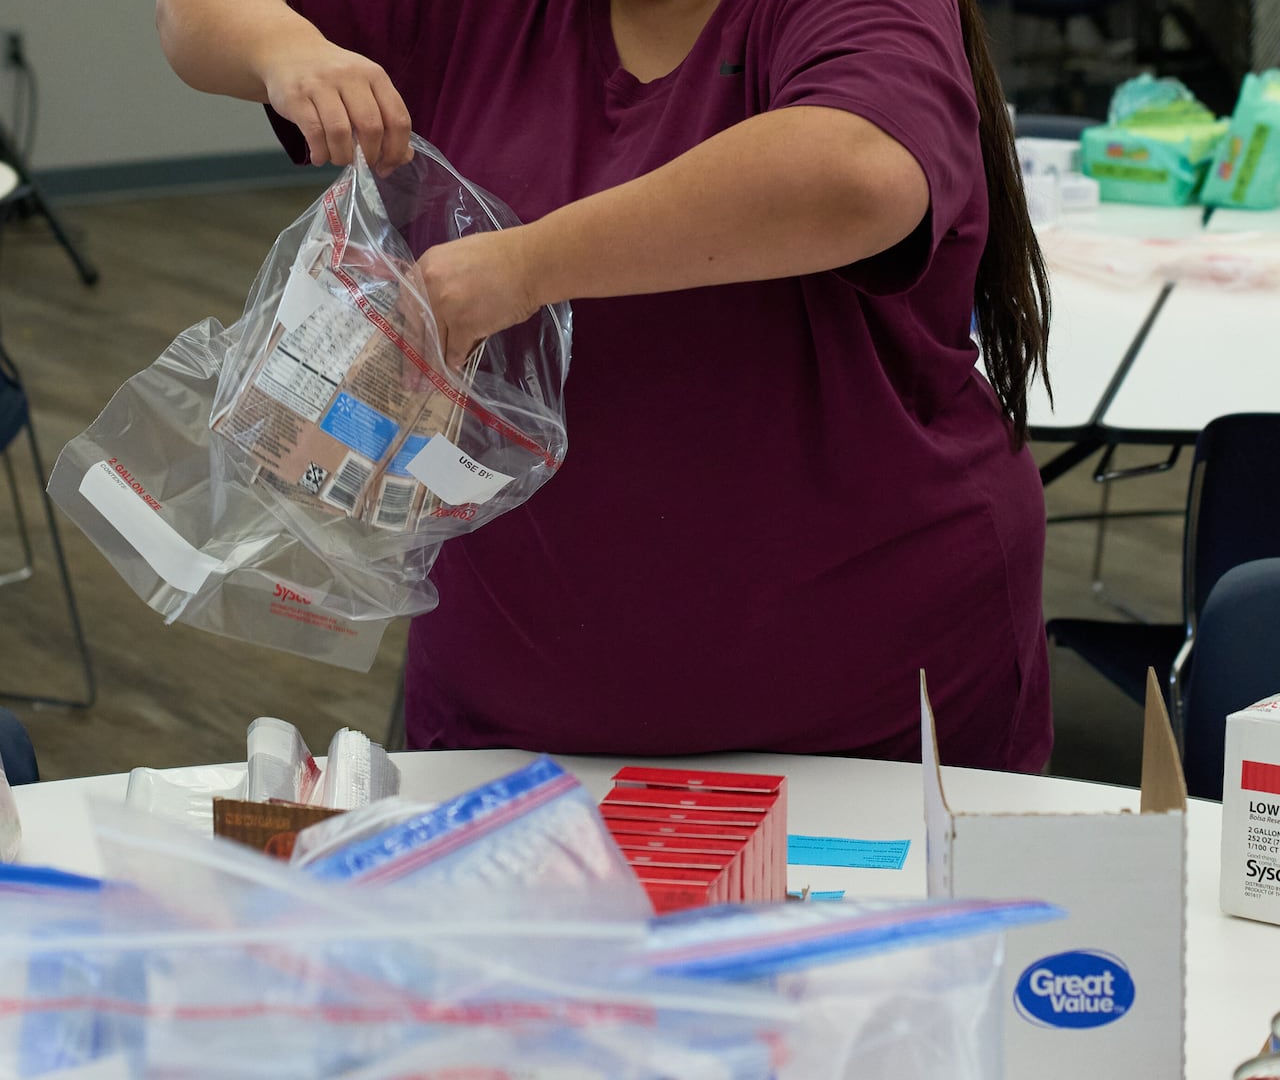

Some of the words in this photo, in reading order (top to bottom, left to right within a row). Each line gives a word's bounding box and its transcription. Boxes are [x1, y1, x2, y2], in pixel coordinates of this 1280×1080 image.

[459, 455, 479, 473] USE
[478, 469, 494, 481] BY:
[108, 457, 118, 466] 2
[115, 464, 146, 495] GALLON
[143, 494, 163, 511] SIZE
[1249, 800, 1280, 816] LOW
[1249, 814, 1266, 823] Bolsa
[1247, 835, 1261, 843] 252
[1261, 837, 1272, 845] OZ
[1248, 842, 1267, 852] 1/100
[1269, 846, 1279, 854] CT
[1029, 967, 1115, 997] Great
[1050, 994, 1115, 1013] Value
